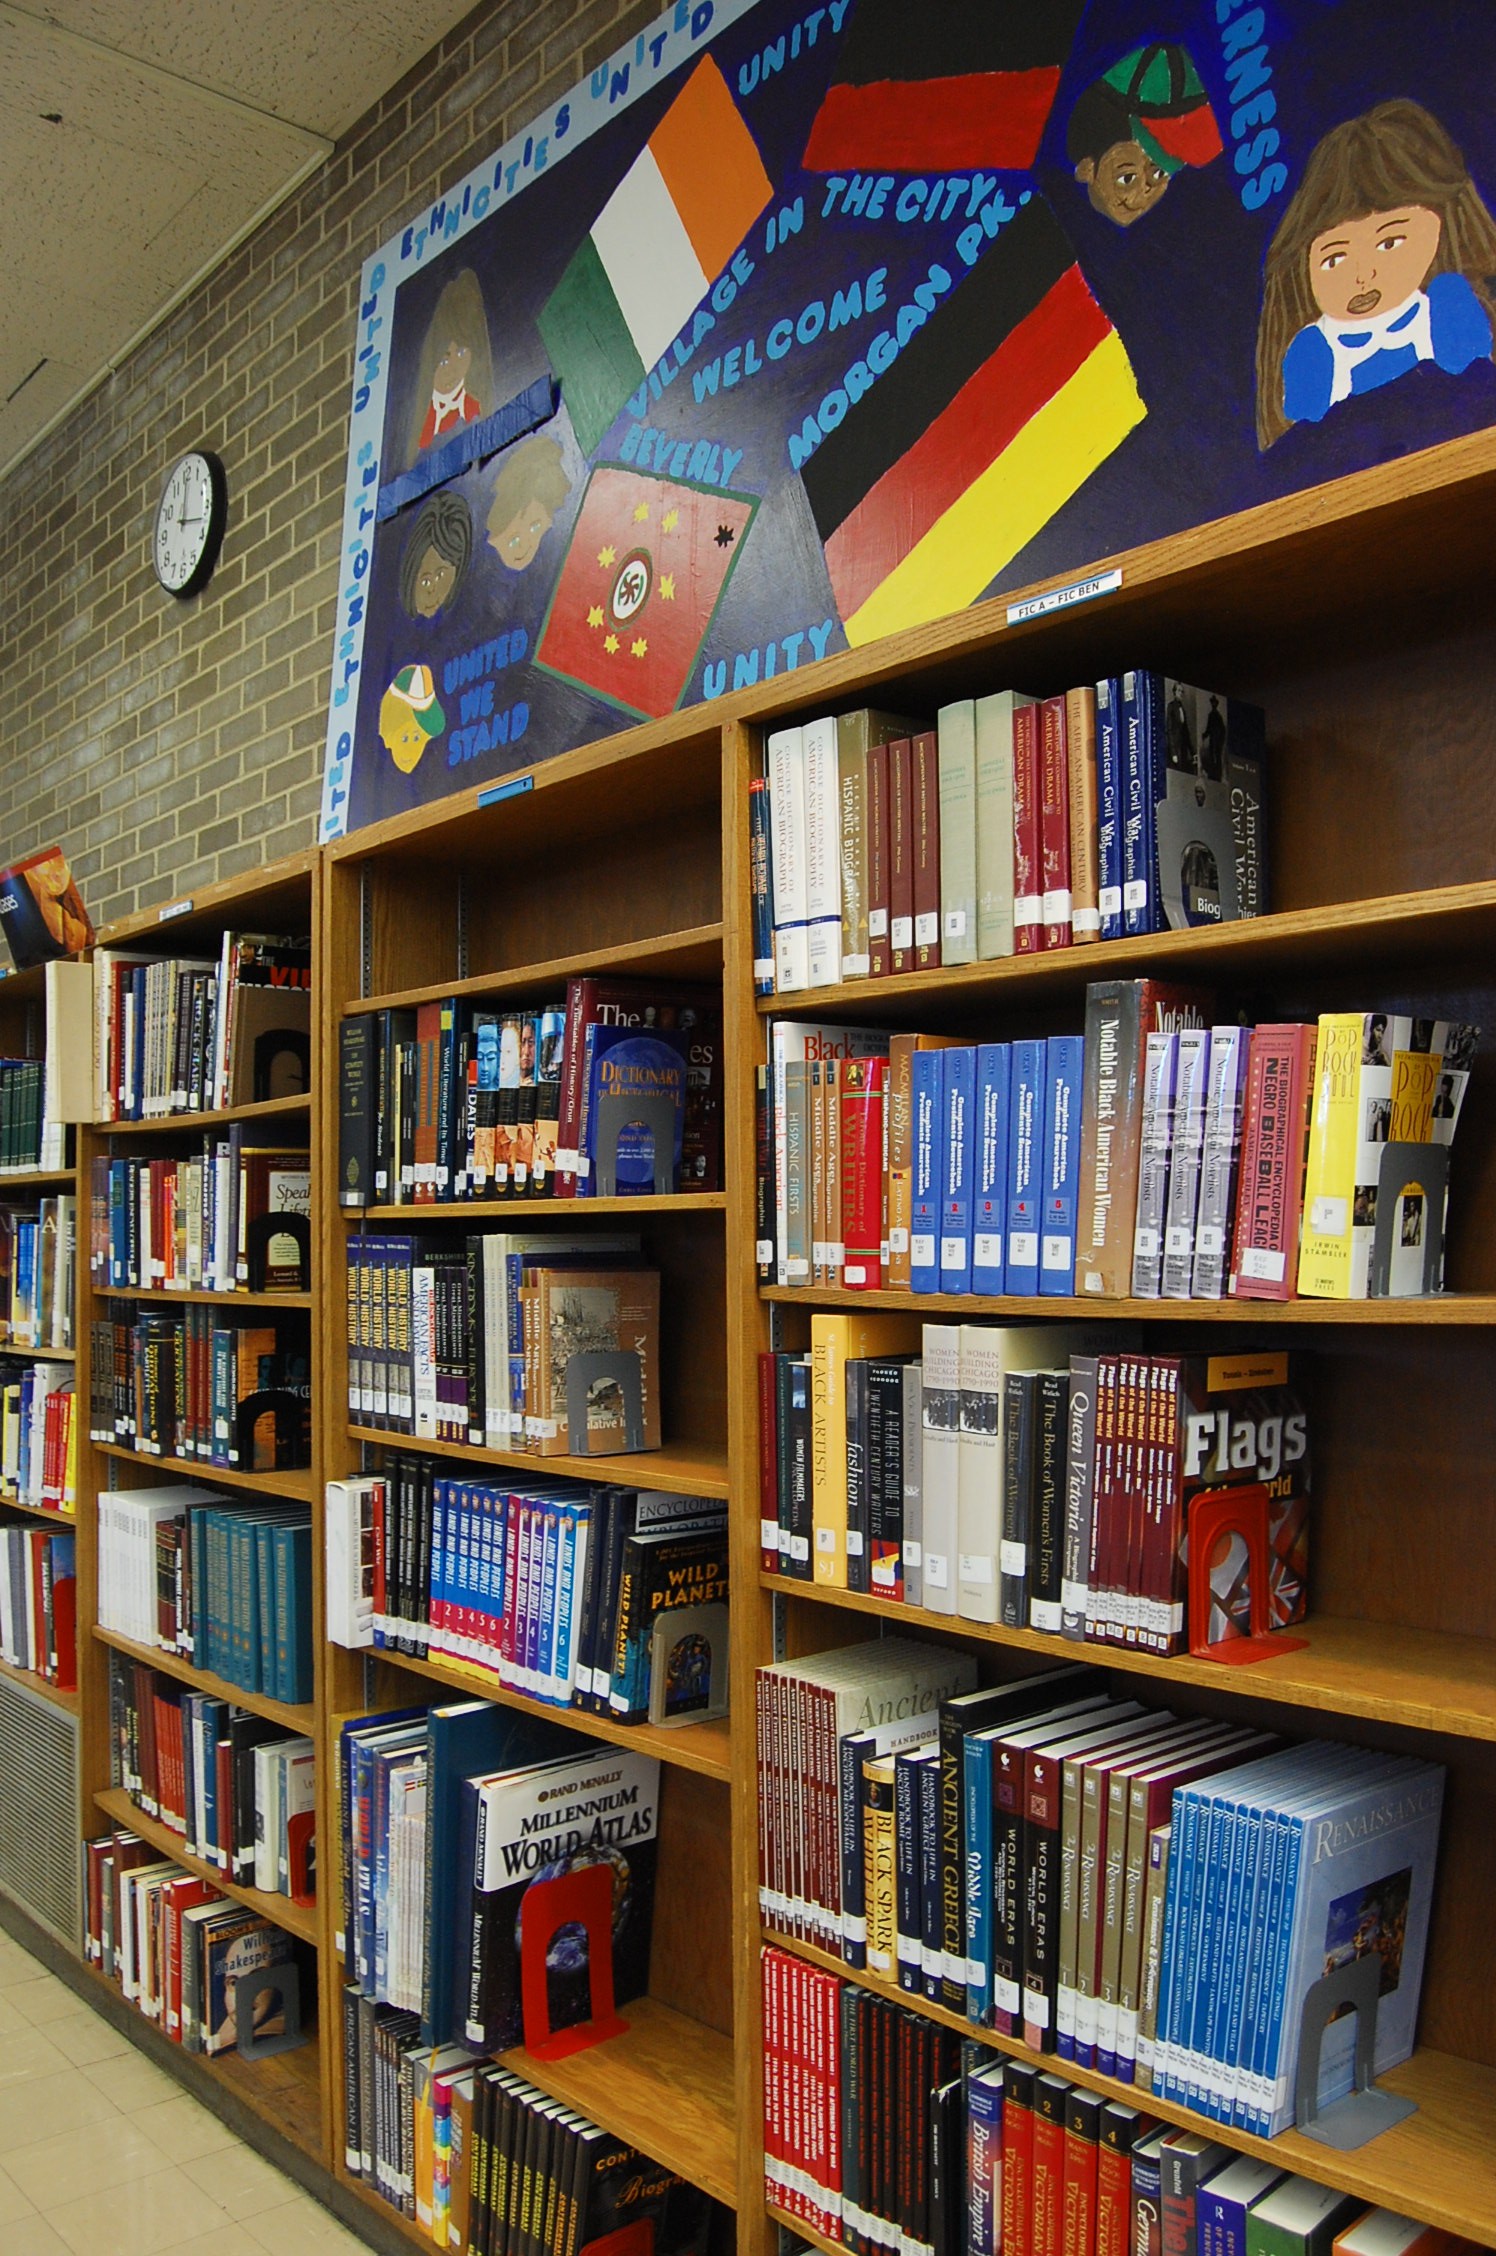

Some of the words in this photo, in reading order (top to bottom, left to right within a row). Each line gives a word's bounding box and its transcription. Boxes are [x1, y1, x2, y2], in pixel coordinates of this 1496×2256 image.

[737, 0, 848, 96] UNITY
[401, 104, 571, 260] ETHNICITIES
[590, 0, 716, 104] UNITED
[626, 249, 756, 422] VILLAGE
[764, 196, 804, 253] IN
[822, 174, 894, 219] THE
[895, 172, 997, 222] CITY
[354, 262, 387, 414] UNITED
[692, 266, 888, 403] WELCOME
[787, 264, 952, 469] MORGAN
[183, 466, 191, 485] 12
[620, 424, 744, 488] BEVERLY
[161, 530, 168, 546] 9
[162, 505, 173, 523] 10
[164, 551, 170, 567] 8
[180, 563, 186, 579] 6
[334, 440, 377, 708] ETHNICITIES
[1018, 605, 1036, 617] FIC
[1039, 602, 1045, 610] A
[1058, 591, 1075, 604] FIC
[1078, 582, 1100, 596] BEN
[444, 628, 529, 695] UNITED
[703, 620, 834, 700] UNITY
[460, 681, 495, 728] WE
[448, 702, 531, 767] STAND
[1044, 711, 1053, 769] AMERICAN
[1129, 716, 1139, 771] American
[807, 739, 816, 811] AMERICAN
[1045, 771, 1054, 806] DRAMA
[1130, 779, 1141, 812] Civil
[843, 776, 854, 833] HISPANIC
[1231, 787, 1243, 844] Civil
[808, 813, 817, 889] BIOGRAPHY
[844, 835, 855, 910] BIOGRAPHY
[1246, 792, 1259, 905] American
[1198, 898, 1221, 919] Biog
[572, 1002, 581, 1052] Timetables
[597, 1004, 640, 1027] The
[803, 1031, 855, 1061] Black
[1100, 1019, 1119, 1075] Notable
[1280, 1056, 1289, 1077] THE
[601, 1061, 680, 1085] DICTIONARY
[1265, 1058, 1279, 1110] NEGRO
[467, 1094, 477, 1141] DATES
[1099, 1079, 1116, 1120] Black
[1276, 1080, 1288, 1159] BIOGRAPHICAL
[789, 1112, 800, 1173] HISPANIC
[892, 1094, 905, 1162] profiles
[1097, 1122, 1115, 1192] American
[1256, 1115, 1274, 1200] BASEBALL
[789, 1176, 800, 1214] FIRSTS
[1018, 1202, 1025, 1211] 4
[1093, 1193, 1112, 1248] Women
[1271, 1162, 1285, 1238] ENCYCLOPEDIA
[373, 1268, 382, 1303] WORLD
[373, 1306, 383, 1349] HISTORY
[815, 1345, 826, 1404] BLACK
[961, 1367, 999, 1377] CHICAGO
[966, 1350, 999, 1359] WOMEN
[1169, 1370, 1177, 1392] Flags
[1043, 1400, 1056, 1427] The
[1071, 1392, 1089, 1455] Queen
[1167, 1419, 1175, 1444] World
[815, 1412, 827, 1487] ARTISTS
[885, 1421, 899, 1469] READER'S
[1043, 1430, 1055, 1465] Book
[1184, 1410, 1306, 1481] Flags
[846, 1441, 863, 1507] fashion
[885, 1471, 899, 1502] GUIDE
[1043, 1467, 1053, 1481] of
[1068, 1461, 1087, 1531] Victoria
[871, 1493, 882, 1535] WRITERS
[885, 1505, 899, 1518] TO
[1040, 1483, 1053, 1546] Women's
[565, 1538, 573, 1575] LANDS
[668, 1563, 719, 1586] WILD
[1040, 1549, 1053, 1586] Firsts
[559, 1598, 570, 1628] PEOPLES
[651, 1581, 730, 1609] PLANET
[559, 1635, 565, 1646] 6
[890, 1728, 938, 1747] HANDBOOK
[520, 1785, 640, 1838] MILLENNIUM
[550, 1783, 578, 1800] RAND
[943, 1749, 958, 1860] ANCIENT
[501, 1830, 580, 1877] WORLD
[589, 1807, 653, 1849] ATLAS
[877, 1815, 892, 1882] BLACK
[1007, 1828, 1016, 1890] WORLD
[967, 1851, 981, 1902] Middle
[1038, 1841, 1047, 1904] WORLD
[877, 1890, 892, 1951] SPARK
[943, 1865, 959, 1954] GREECE
[1007, 1899, 1015, 1945] ERAS
[1036, 1913, 1044, 1960] ERAS
[1043, 2101, 1051, 2112] 2
[1074, 2117, 1083, 2130] 3
[972, 2120, 990, 2181] British
[1108, 2131, 1116, 2143] 4
[1004, 2148, 1016, 2234] VICTORIAN
[1173, 2161, 1182, 2194] Grunfeld
[969, 2183, 989, 2247] Empire
